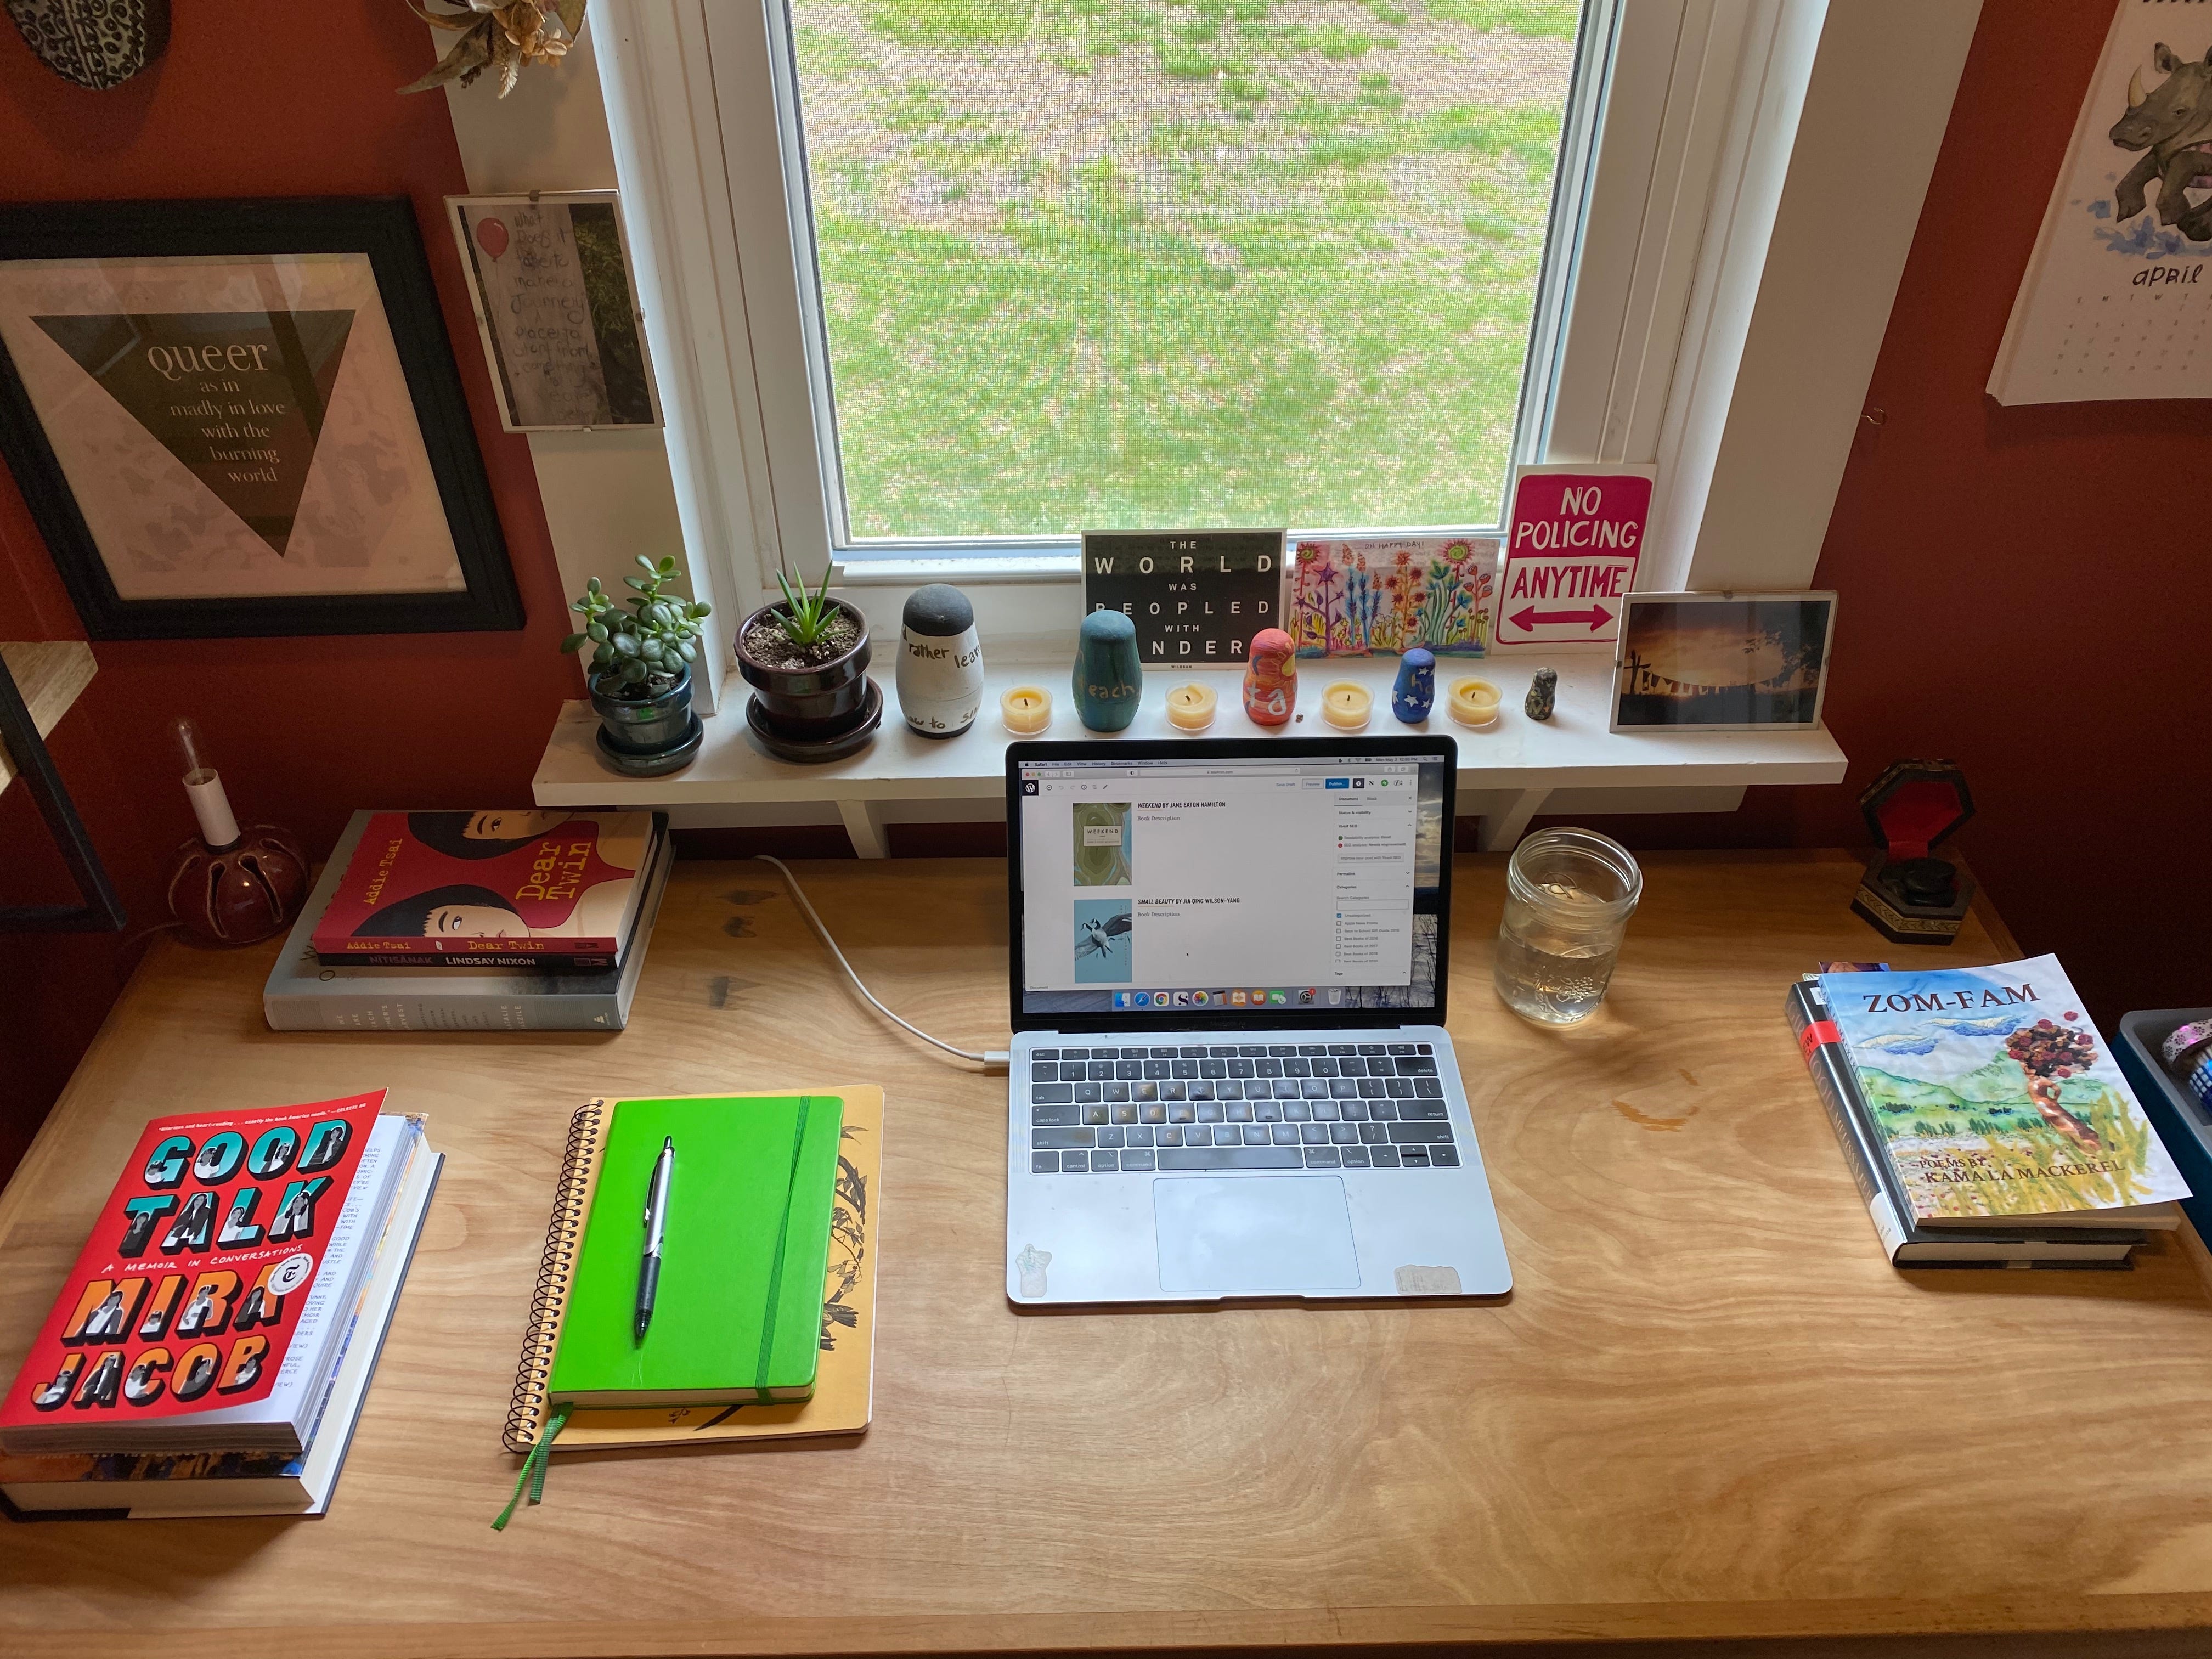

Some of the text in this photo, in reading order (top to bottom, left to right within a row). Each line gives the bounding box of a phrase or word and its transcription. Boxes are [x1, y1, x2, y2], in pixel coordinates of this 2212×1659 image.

[200, 379, 240, 393] as in
[170, 399, 285, 419] madly in love
[201, 422, 271, 438] with the
[210, 446, 280, 464] burning
[228, 467, 277, 482] world
[1560, 486, 1602, 516] NO
[1170, 541, 1197, 549] THE
[1515, 520, 1639, 550] POLICING
[1094, 555, 1272, 574] WORLD
[1168, 583, 1197, 591] WAS
[1510, 565, 1629, 599] ANYTIME
[1165, 624, 1200, 633] WITH
[909, 642, 950, 660] rather
[929, 716, 946, 729] to
[363, 838, 403, 905] Addie Tsai
[515, 841, 561, 900] Dear
[545, 841, 592, 900] Twin
[347, 941, 545, 950] Addie Tsai Dear Twin
[445, 957, 494, 966] LINDSAY
[497, 957, 536, 966] NIXON
[1863, 983, 2041, 1013] ZOM-FAM
[143, 1118, 353, 1192] GOOD
[1919, 1157, 1986, 1170] POEMS BY
[1922, 1160, 2125, 1183] KAMALA MACKEREL
[117, 1177, 335, 1258] TALK
[101, 1244, 304, 1274] A MEMOIR IN CONVERSATIONS
[61, 1262, 284, 1346] MIRA
[31, 1334, 270, 1412] JACOB
